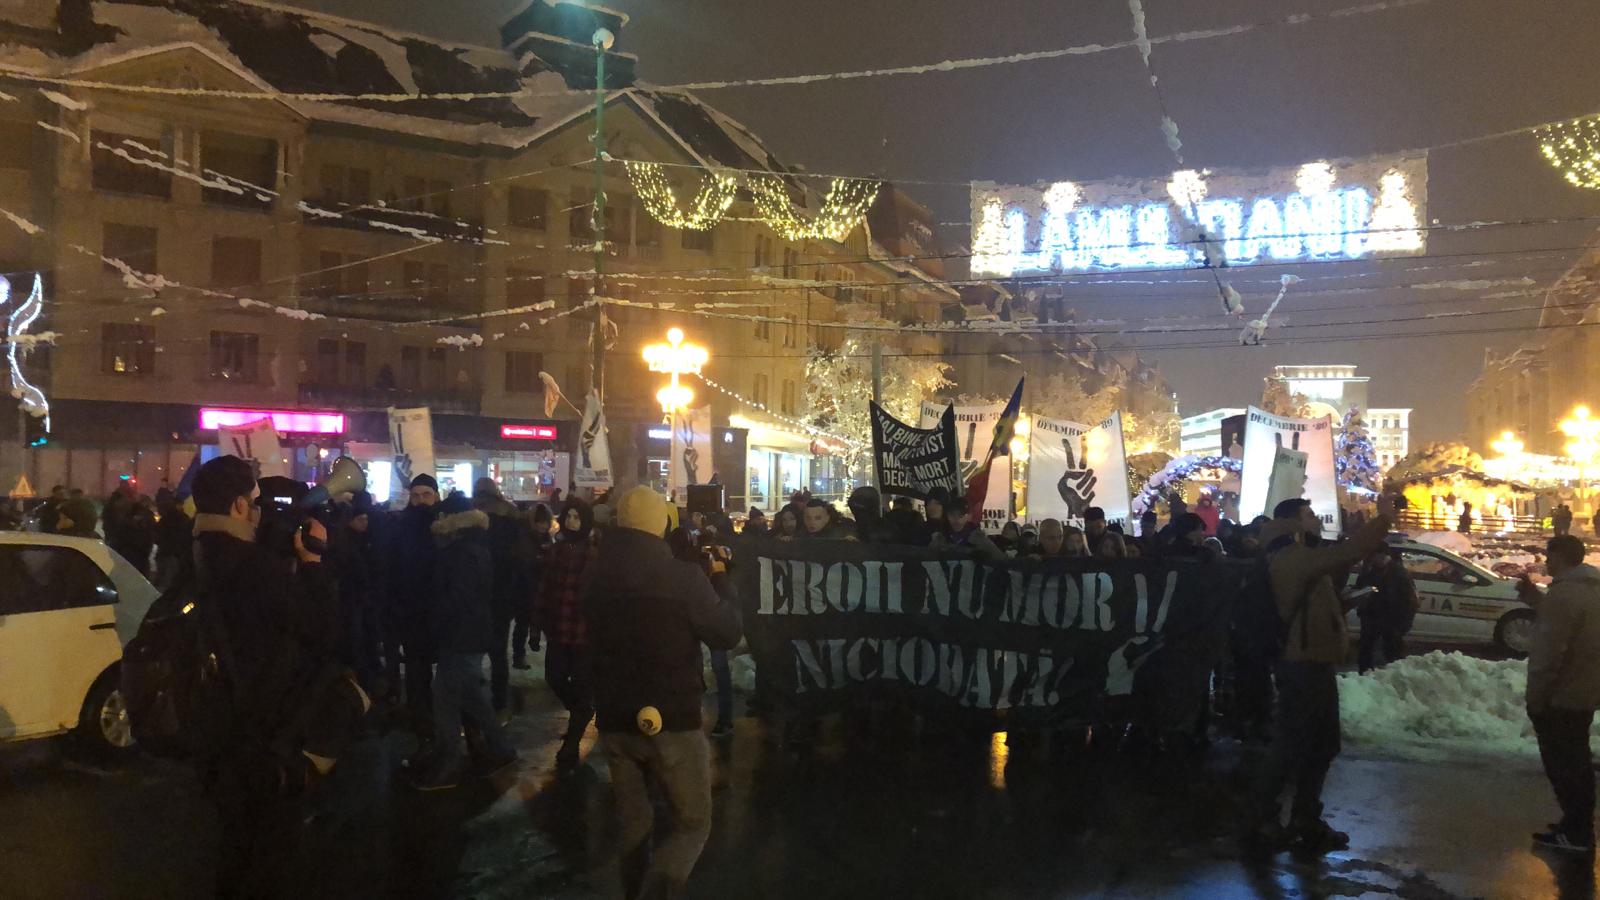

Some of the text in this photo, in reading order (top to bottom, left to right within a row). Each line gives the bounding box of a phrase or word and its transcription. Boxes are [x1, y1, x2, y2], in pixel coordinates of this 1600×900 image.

[914, 457, 949, 481] MORT
[757, 556, 1116, 632] EROII NU MOR
